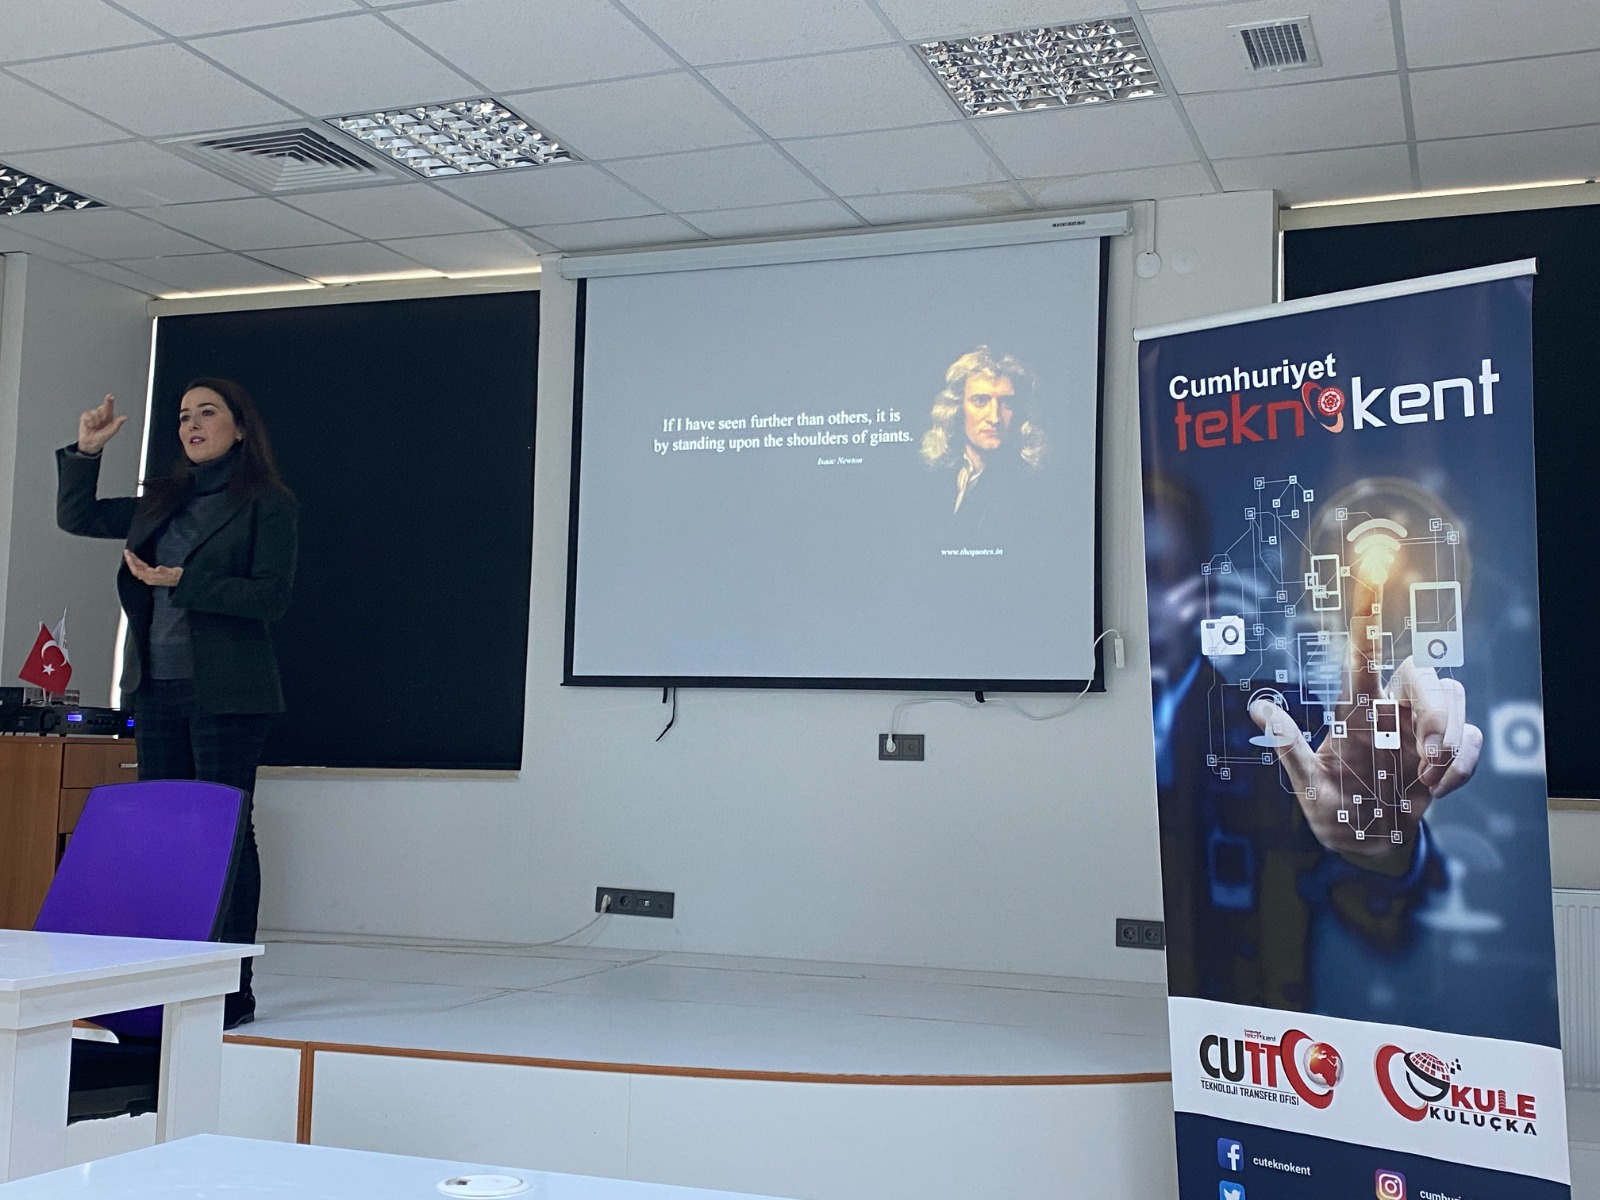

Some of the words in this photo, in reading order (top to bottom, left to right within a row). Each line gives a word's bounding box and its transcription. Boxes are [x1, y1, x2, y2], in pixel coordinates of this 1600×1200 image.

[1169, 352, 1337, 400] Cumhuriyet
[663, 418, 675, 432] If
[677, 418, 681, 431] I
[685, 417, 715, 431] have
[718, 419, 746, 430] seen
[750, 413, 794, 428] further
[797, 412, 824, 426] than
[827, 410, 872, 425] others,
[876, 408, 886, 422] it
[889, 408, 901, 422] is
[654, 439, 669, 456] by
[672, 436, 725, 453] standing
[729, 438, 760, 452] upon
[763, 433, 783, 447] the
[786, 431, 848, 447] shoulders
[852, 430, 868, 444] of
[869, 429, 914, 447] giants.
[817, 457, 836, 466] Isaac
[837, 457, 863, 465] Newton
[1240, 1088, 1278, 1102] TRANSFER
[1429, 1106, 1537, 1136] KULUÇKA
[1253, 1156, 1311, 1176] cuteknokent
